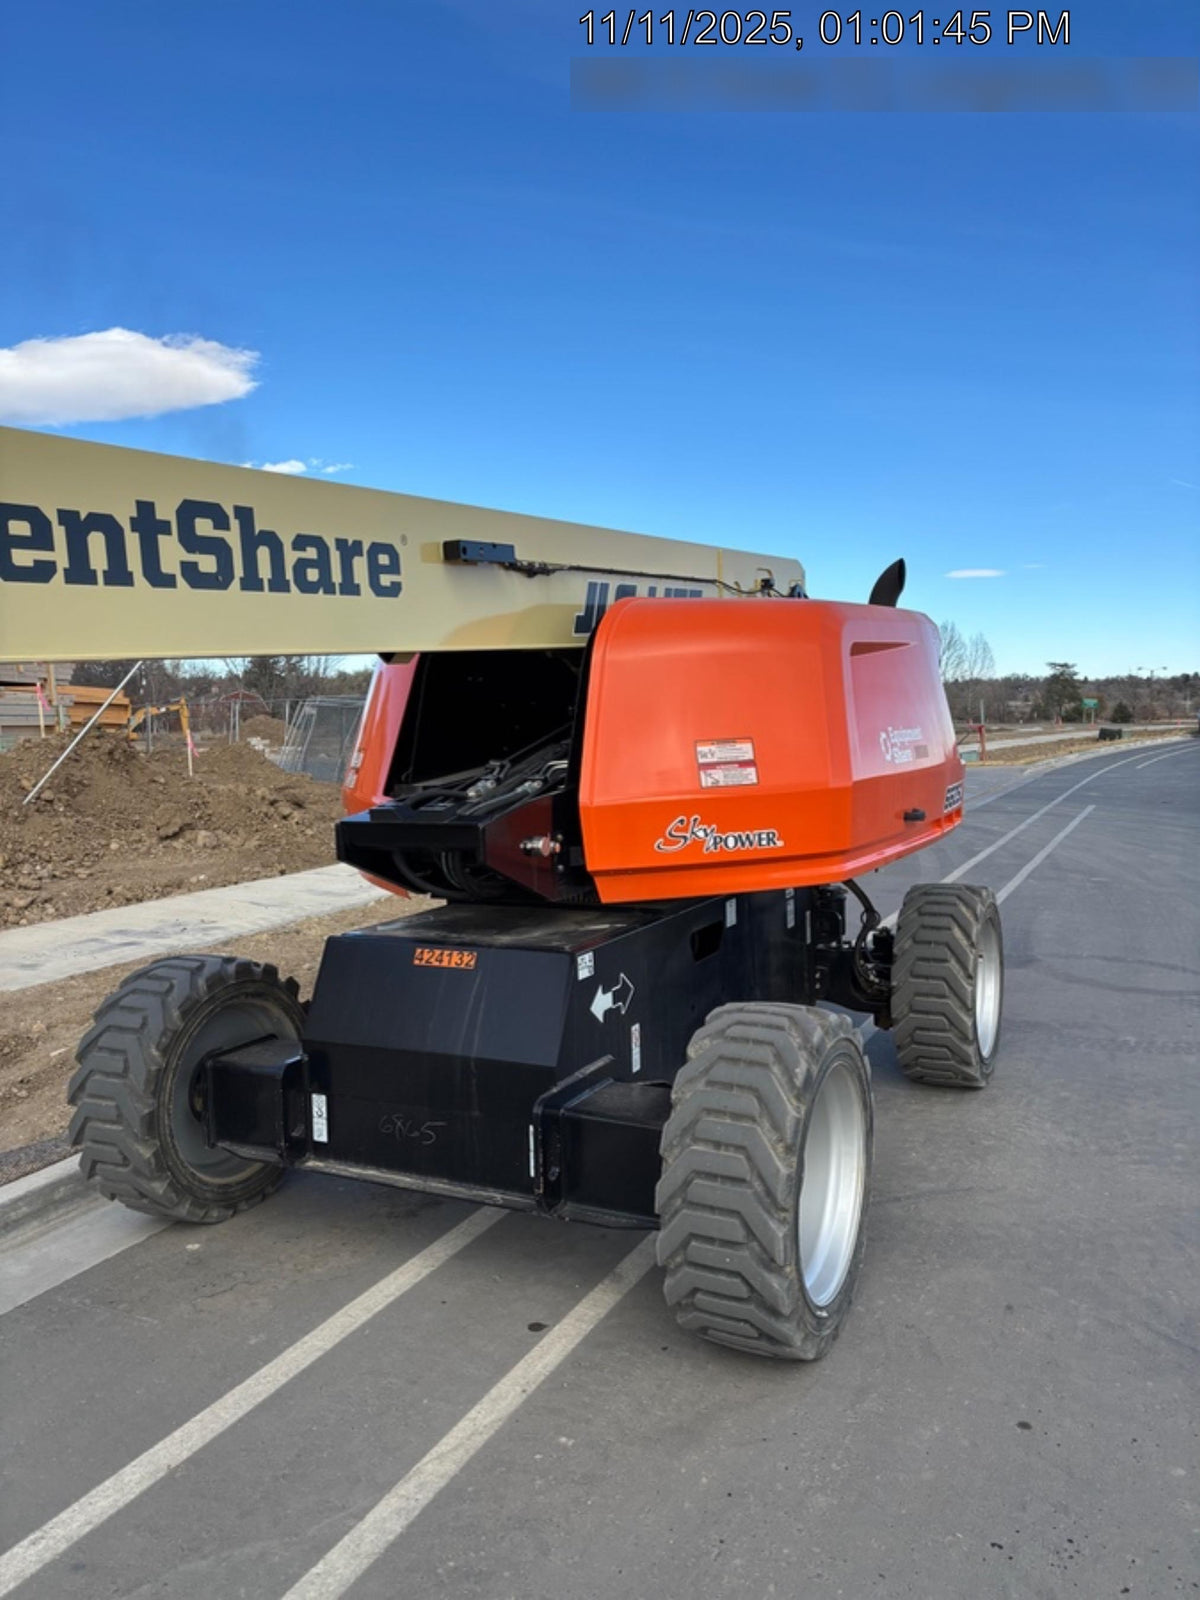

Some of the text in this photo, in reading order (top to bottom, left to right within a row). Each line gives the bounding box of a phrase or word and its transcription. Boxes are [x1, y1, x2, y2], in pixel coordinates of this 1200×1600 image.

[655, 815, 784, 854] Sky POWER
[414, 949, 475, 968] 424132
